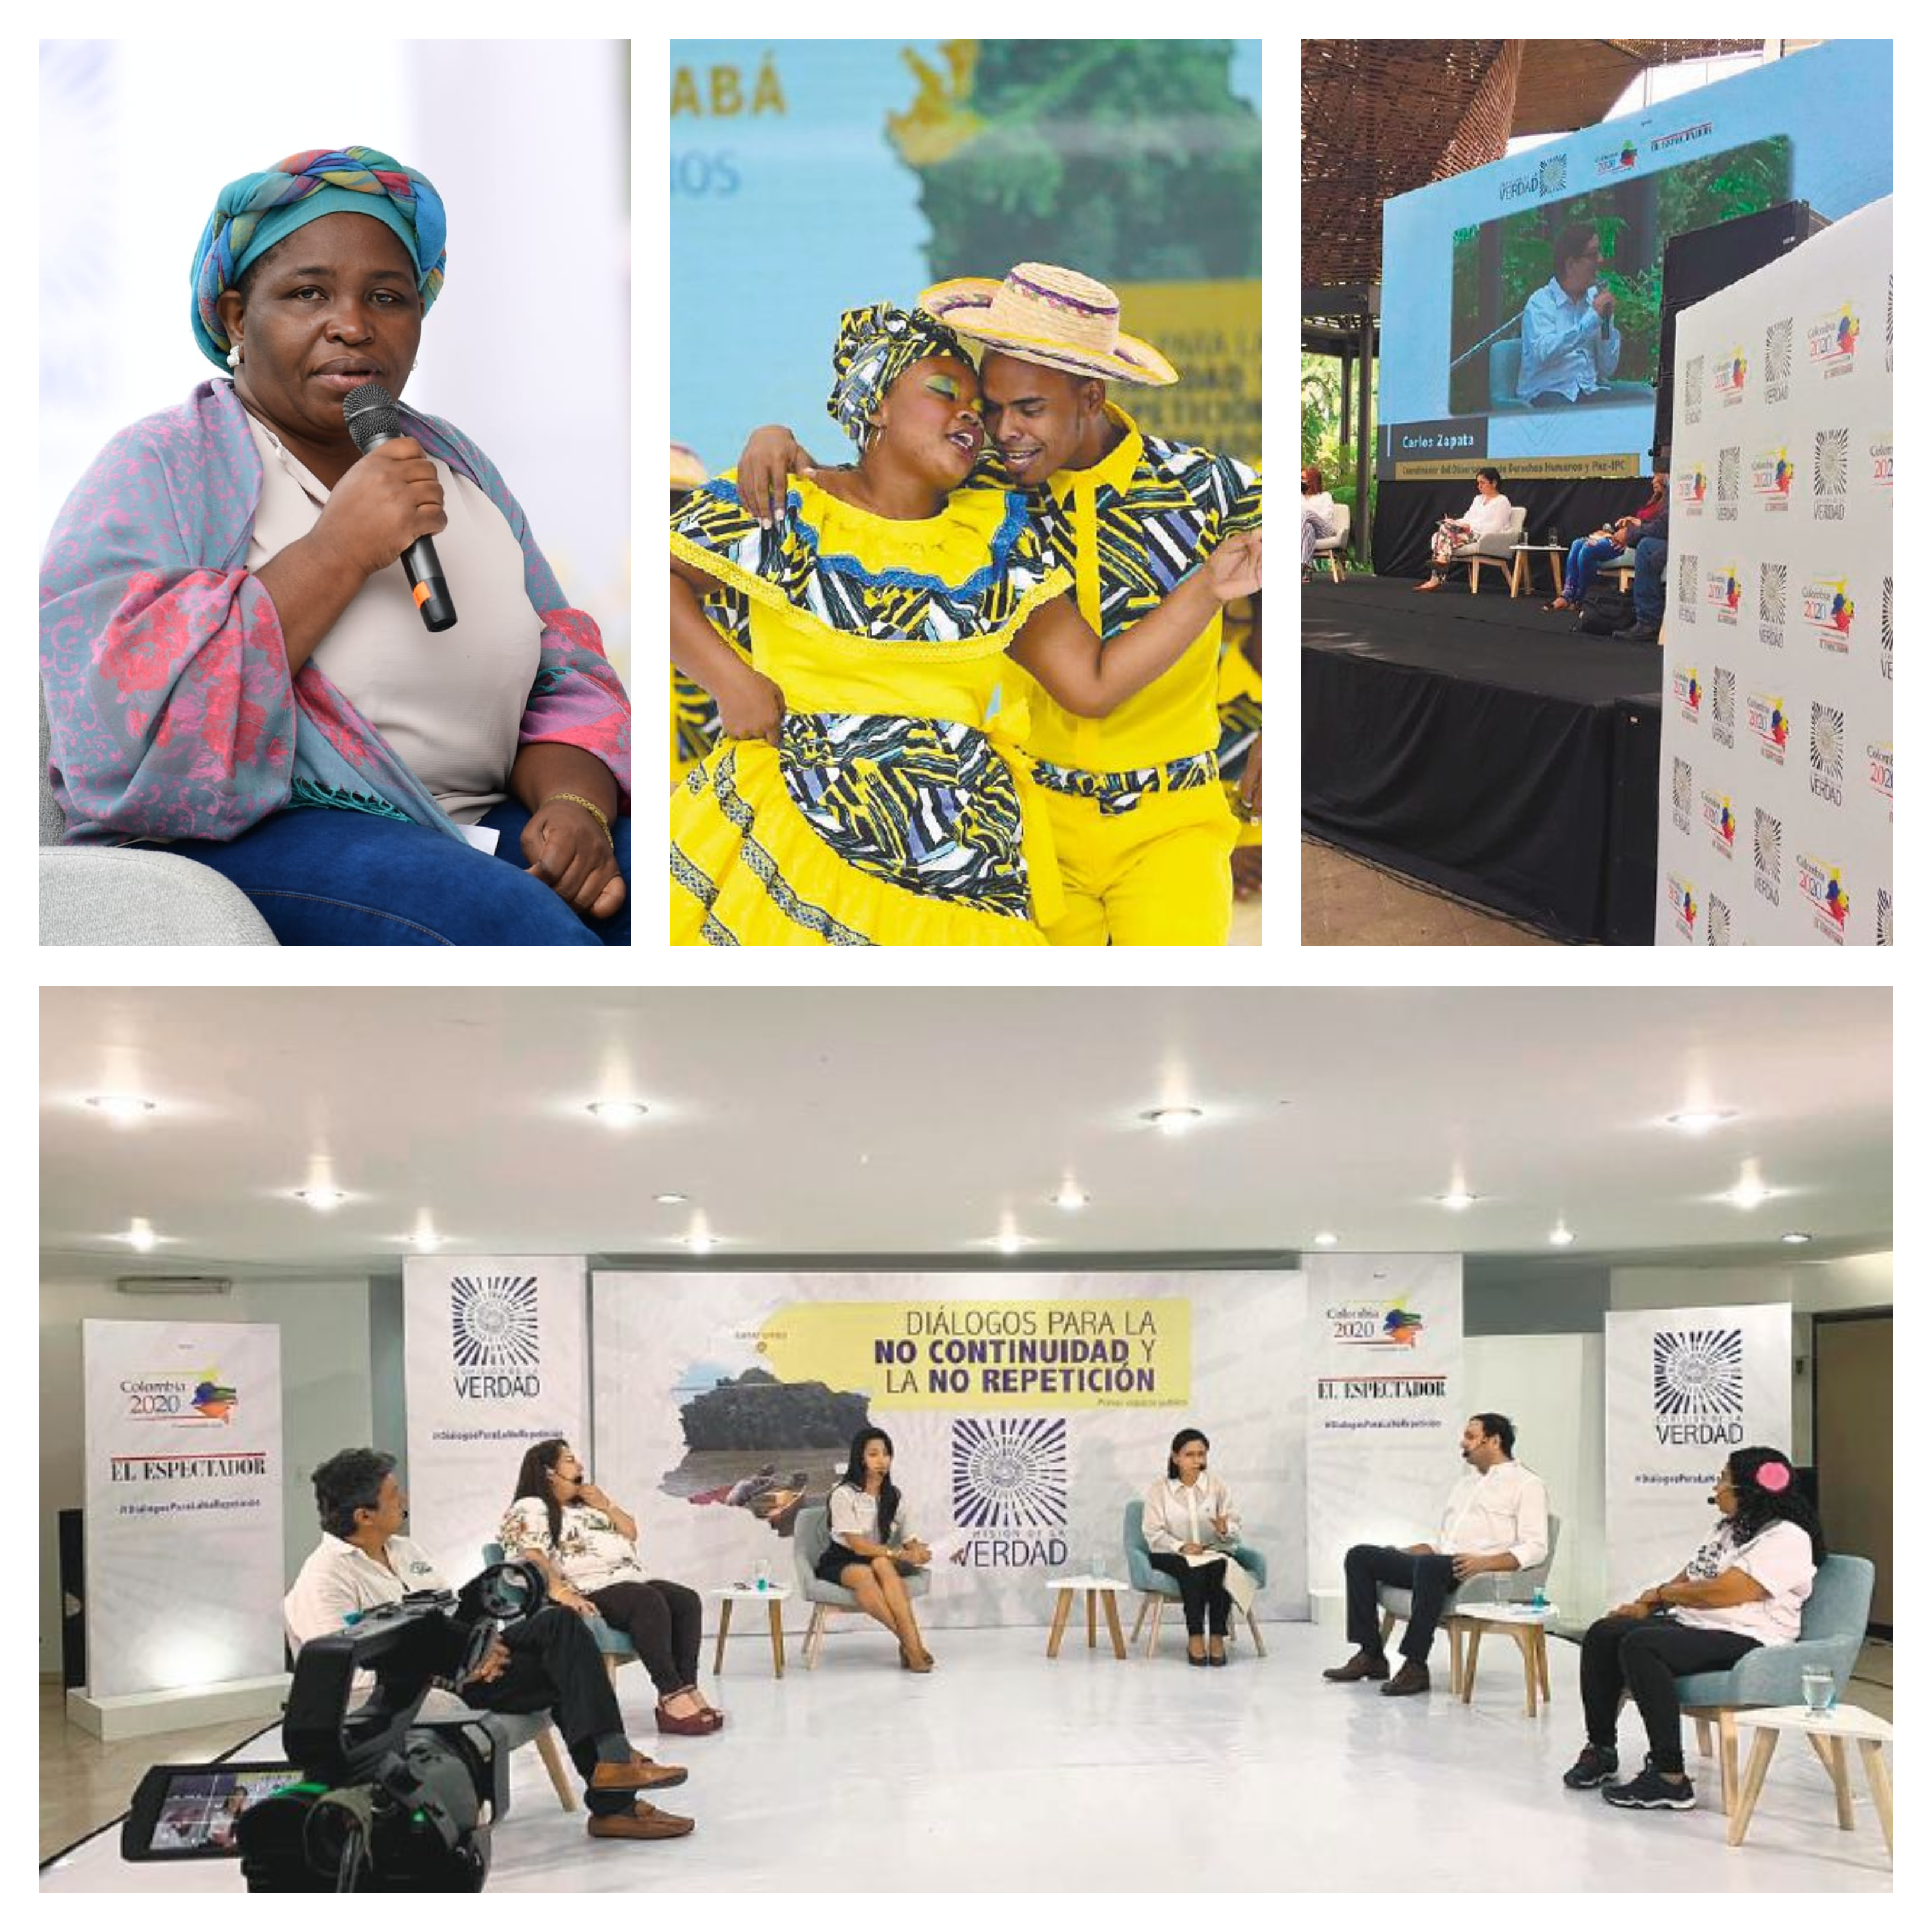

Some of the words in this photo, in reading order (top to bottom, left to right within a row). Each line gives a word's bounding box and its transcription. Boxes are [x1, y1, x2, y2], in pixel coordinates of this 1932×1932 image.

[1499, 178, 1538, 201] VERDAD
[1403, 435, 1433, 448] Carlos
[1437, 433, 1474, 448] Zapata
[1814, 504, 1845, 521] VERDAD
[1804, 600, 1826, 620] 2020
[1811, 774, 1841, 806] VERDAD
[1799, 871, 1822, 900] 2020
[907, 1306, 1036, 1335] DIÁLOGOS
[1049, 1311, 1115, 1335] PARA
[1125, 1310, 1156, 1335] LA
[1334, 1321, 1374, 1338] 2020
[875, 1339, 917, 1363] NO
[929, 1339, 1129, 1363] CONTINUIDAD
[1141, 1339, 1155, 1362] Y
[120, 1381, 186, 1392] Colombia
[454, 1376, 540, 1399] VERDAD
[887, 1370, 917, 1393] LA
[929, 1369, 970, 1393] NO
[983, 1363, 1154, 1393] REPETICIÓN
[1318, 1382, 1337, 1399] EL
[1345, 1380, 1445, 1398] ESPECTADOR
[130, 1395, 180, 1415] 2020
[1656, 1424, 1743, 1444] VERDAD
[112, 1462, 136, 1482] EL
[144, 1458, 266, 1480] ESPECTADOR
[959, 1539, 1068, 1567] VERDAD
